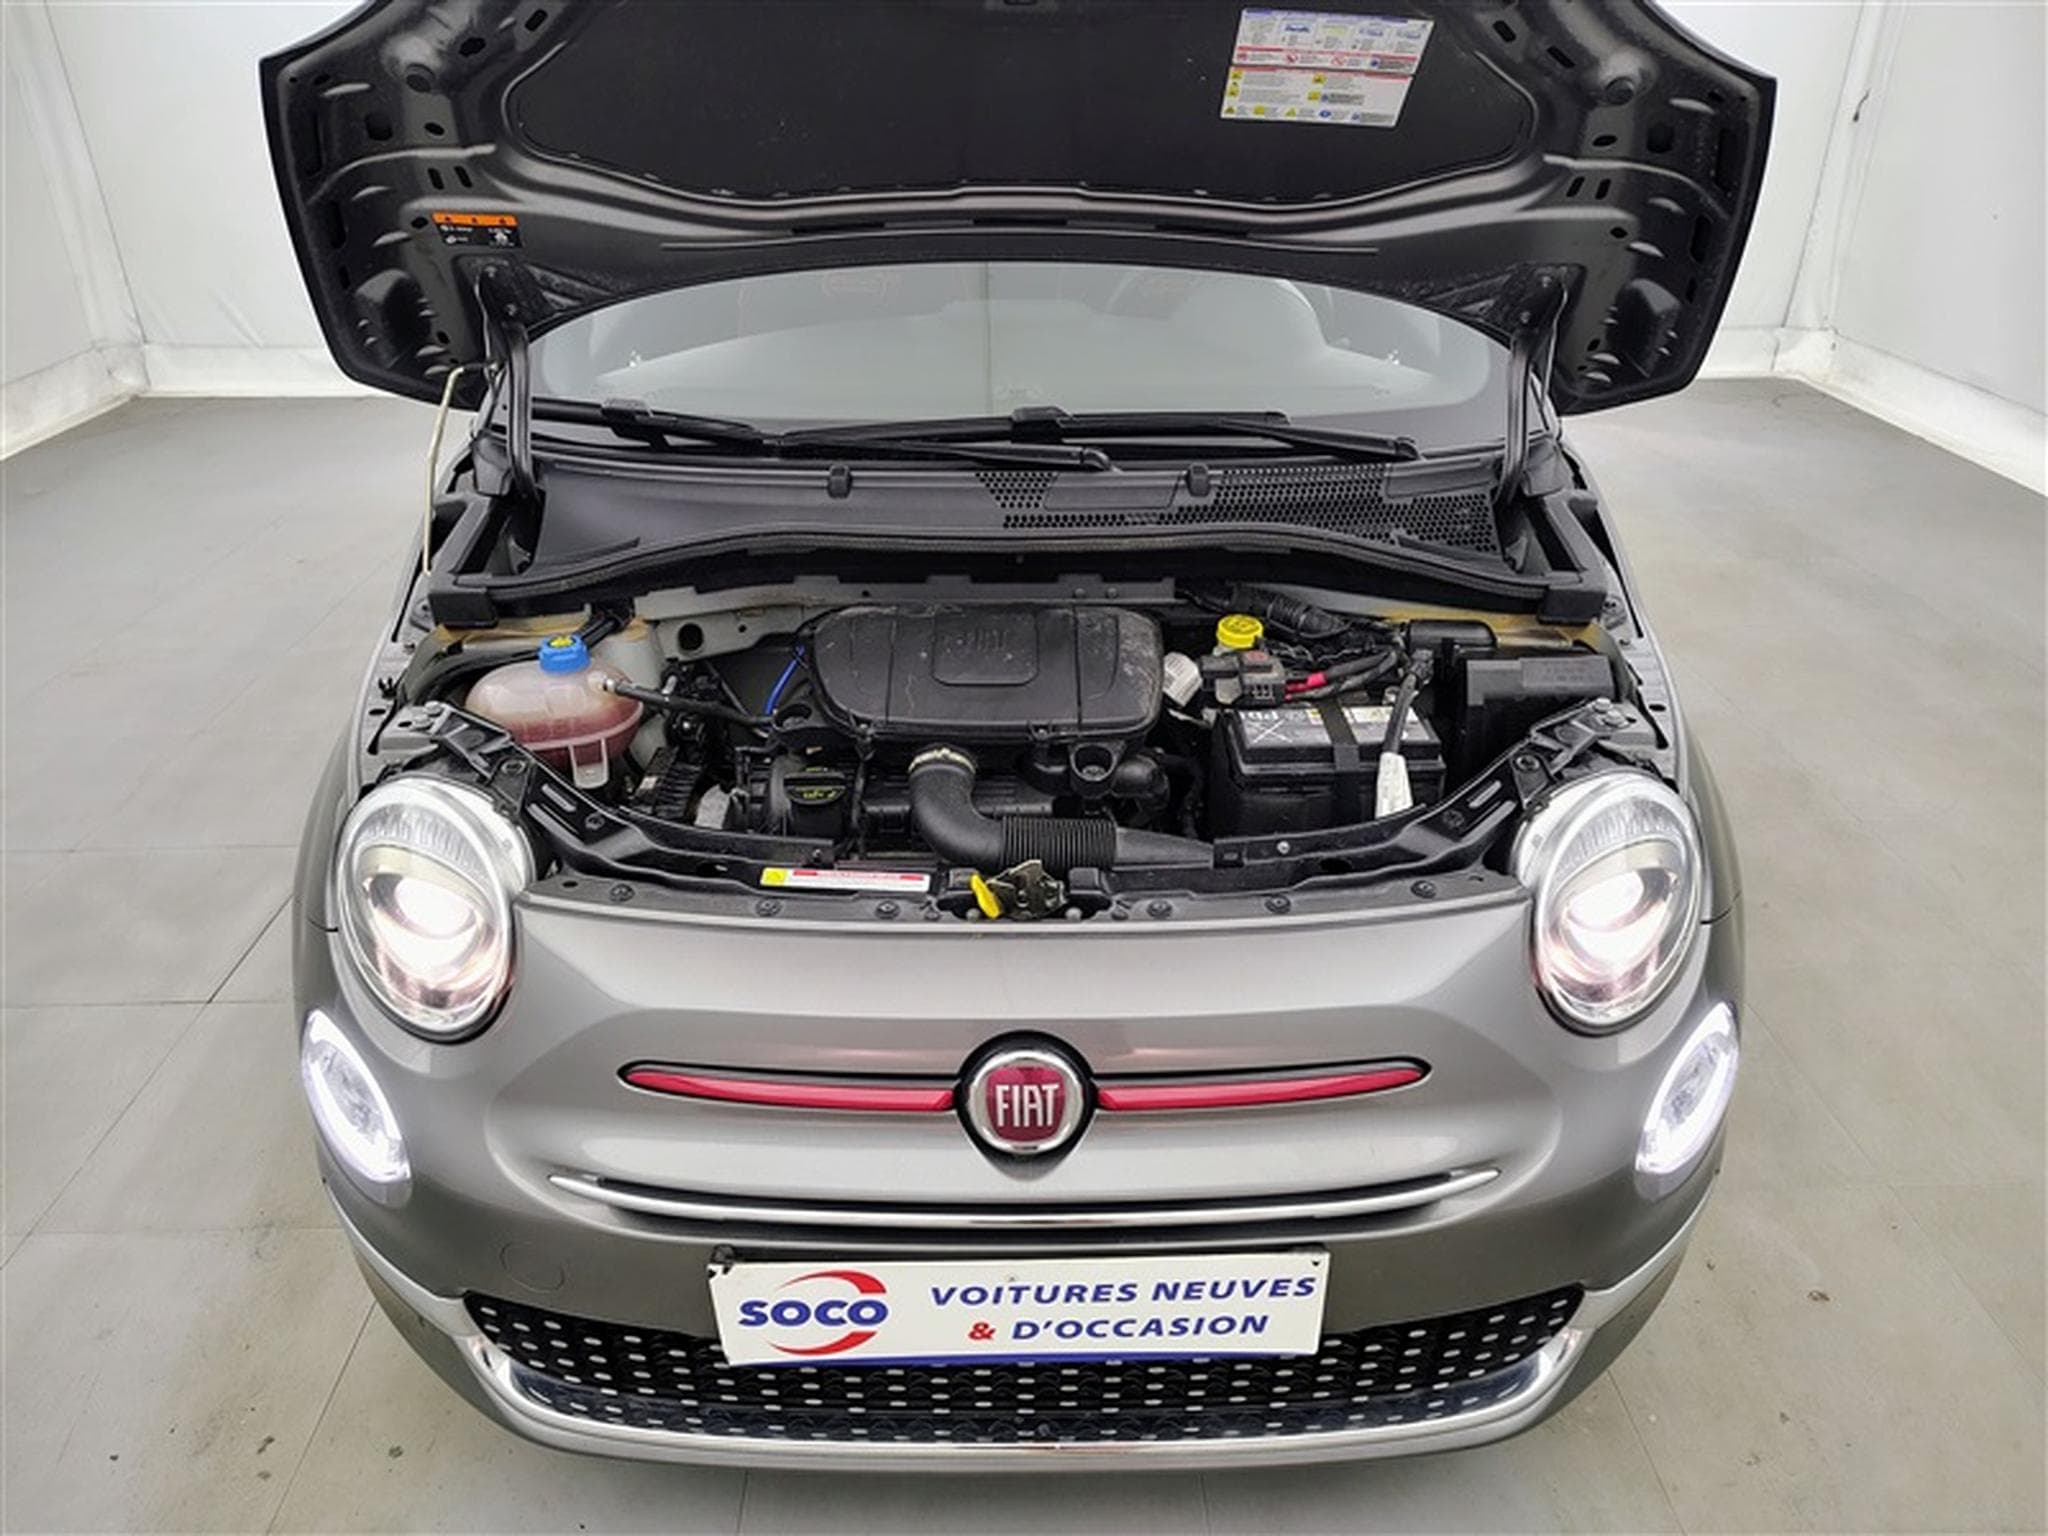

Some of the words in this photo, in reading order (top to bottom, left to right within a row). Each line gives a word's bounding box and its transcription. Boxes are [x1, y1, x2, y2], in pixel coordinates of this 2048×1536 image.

[995, 1084, 1059, 1127] FIAT
[930, 1283, 1138, 1306] VOITURES
[1152, 1277, 1316, 1302] NEUVES
[738, 1299, 889, 1327] SOCO
[967, 1322, 996, 1342] &
[1011, 1315, 1270, 1340] D'OCCASION
